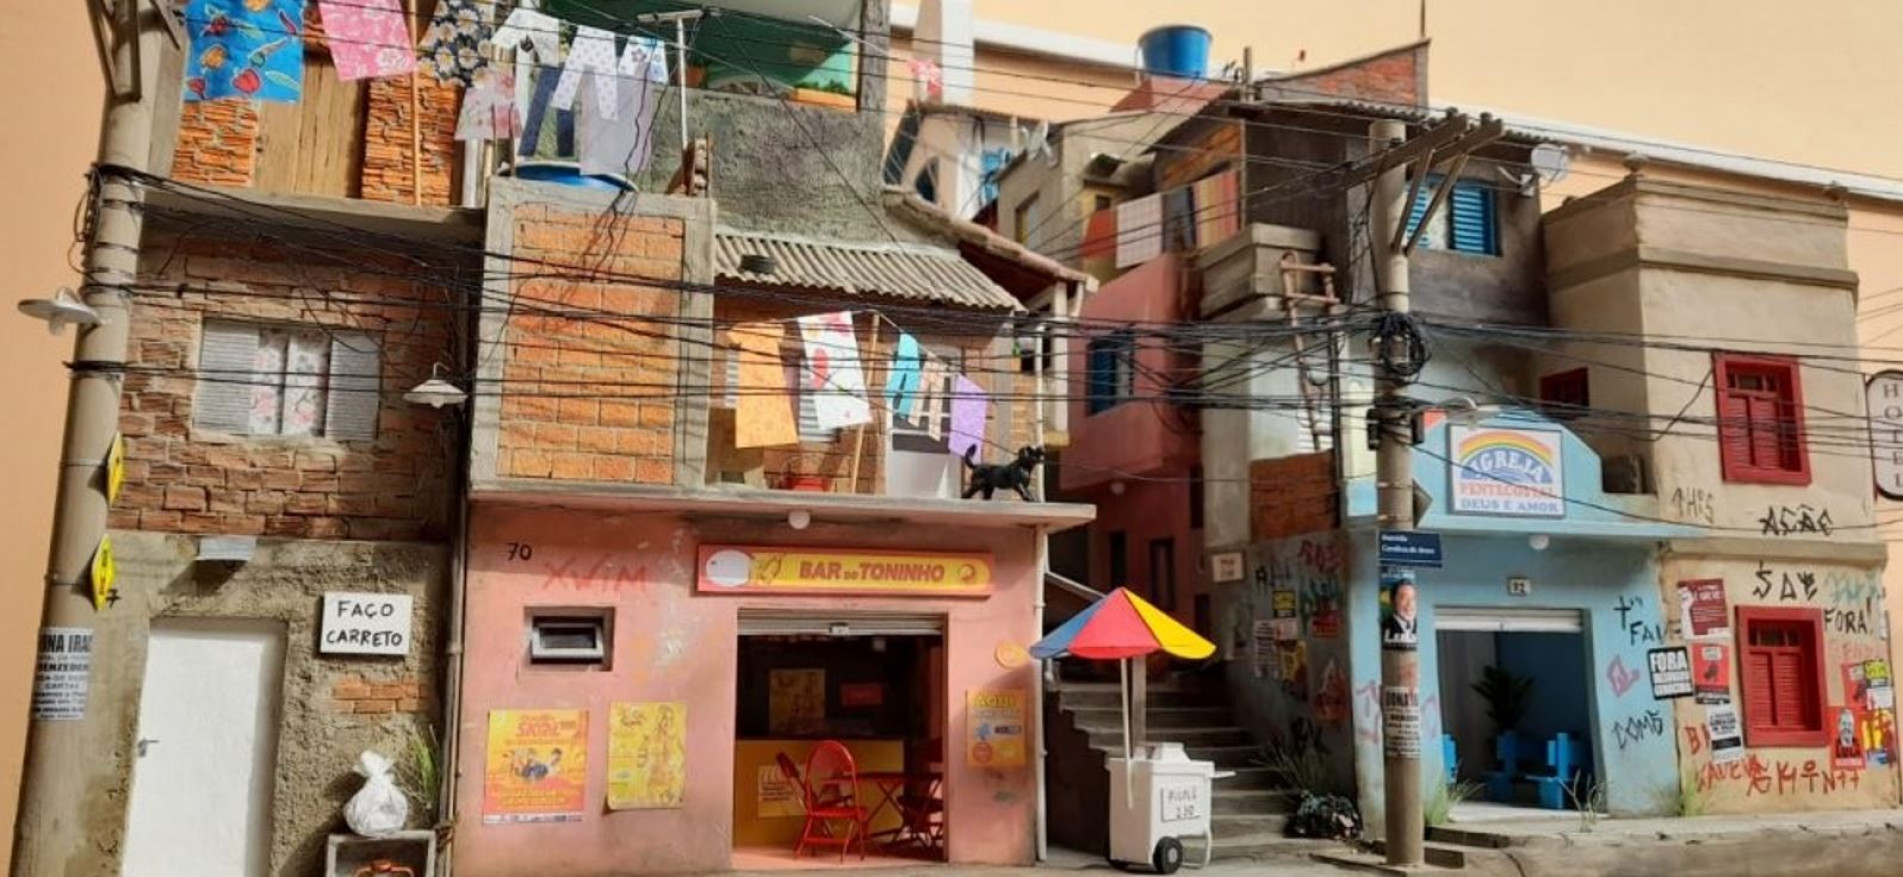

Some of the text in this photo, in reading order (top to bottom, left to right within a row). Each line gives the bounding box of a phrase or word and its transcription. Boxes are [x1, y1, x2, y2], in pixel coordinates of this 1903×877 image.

[1468, 449, 1543, 482] IGREJA
[1462, 498, 1499, 510] DEUS
[1519, 502, 1557, 513] AMOR
[506, 543, 532, 561] 70
[799, 561, 841, 580] BAR
[859, 562, 945, 581] TONINHO
[338, 600, 394, 619] FAÇO
[326, 629, 403, 647] CARRETO
[1650, 650, 1687, 673] FORA
